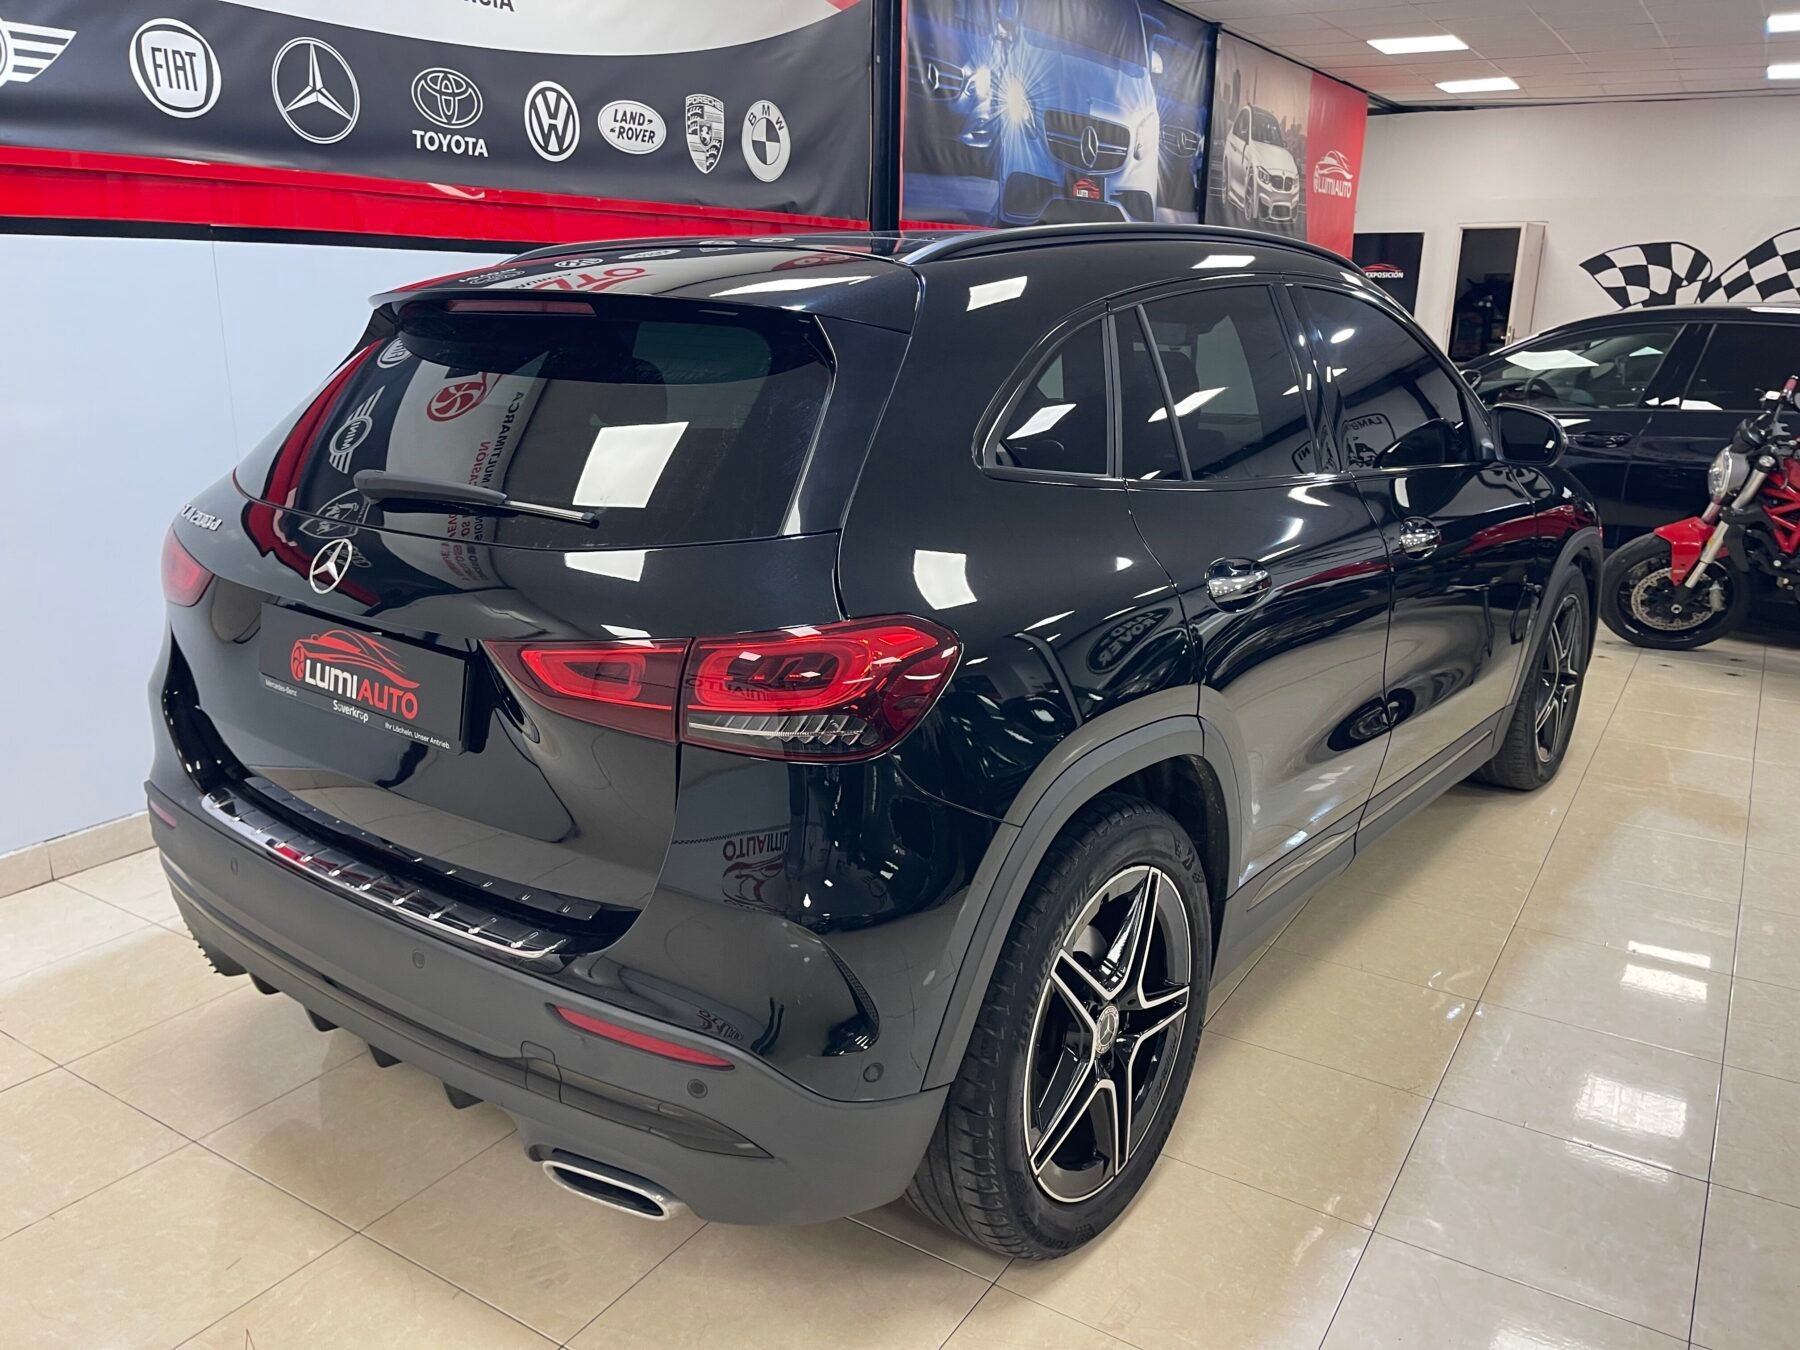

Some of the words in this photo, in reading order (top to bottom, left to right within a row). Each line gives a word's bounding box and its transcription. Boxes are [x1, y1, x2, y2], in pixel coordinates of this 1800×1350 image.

[151, 46, 198, 92] FIAT
[613, 108, 646, 126] LAND
[748, 104, 785, 131] BMW
[412, 129, 489, 158] TOYOTA
[617, 126, 656, 144] ROVER
[304, 658, 419, 720] LUMIAUTO
